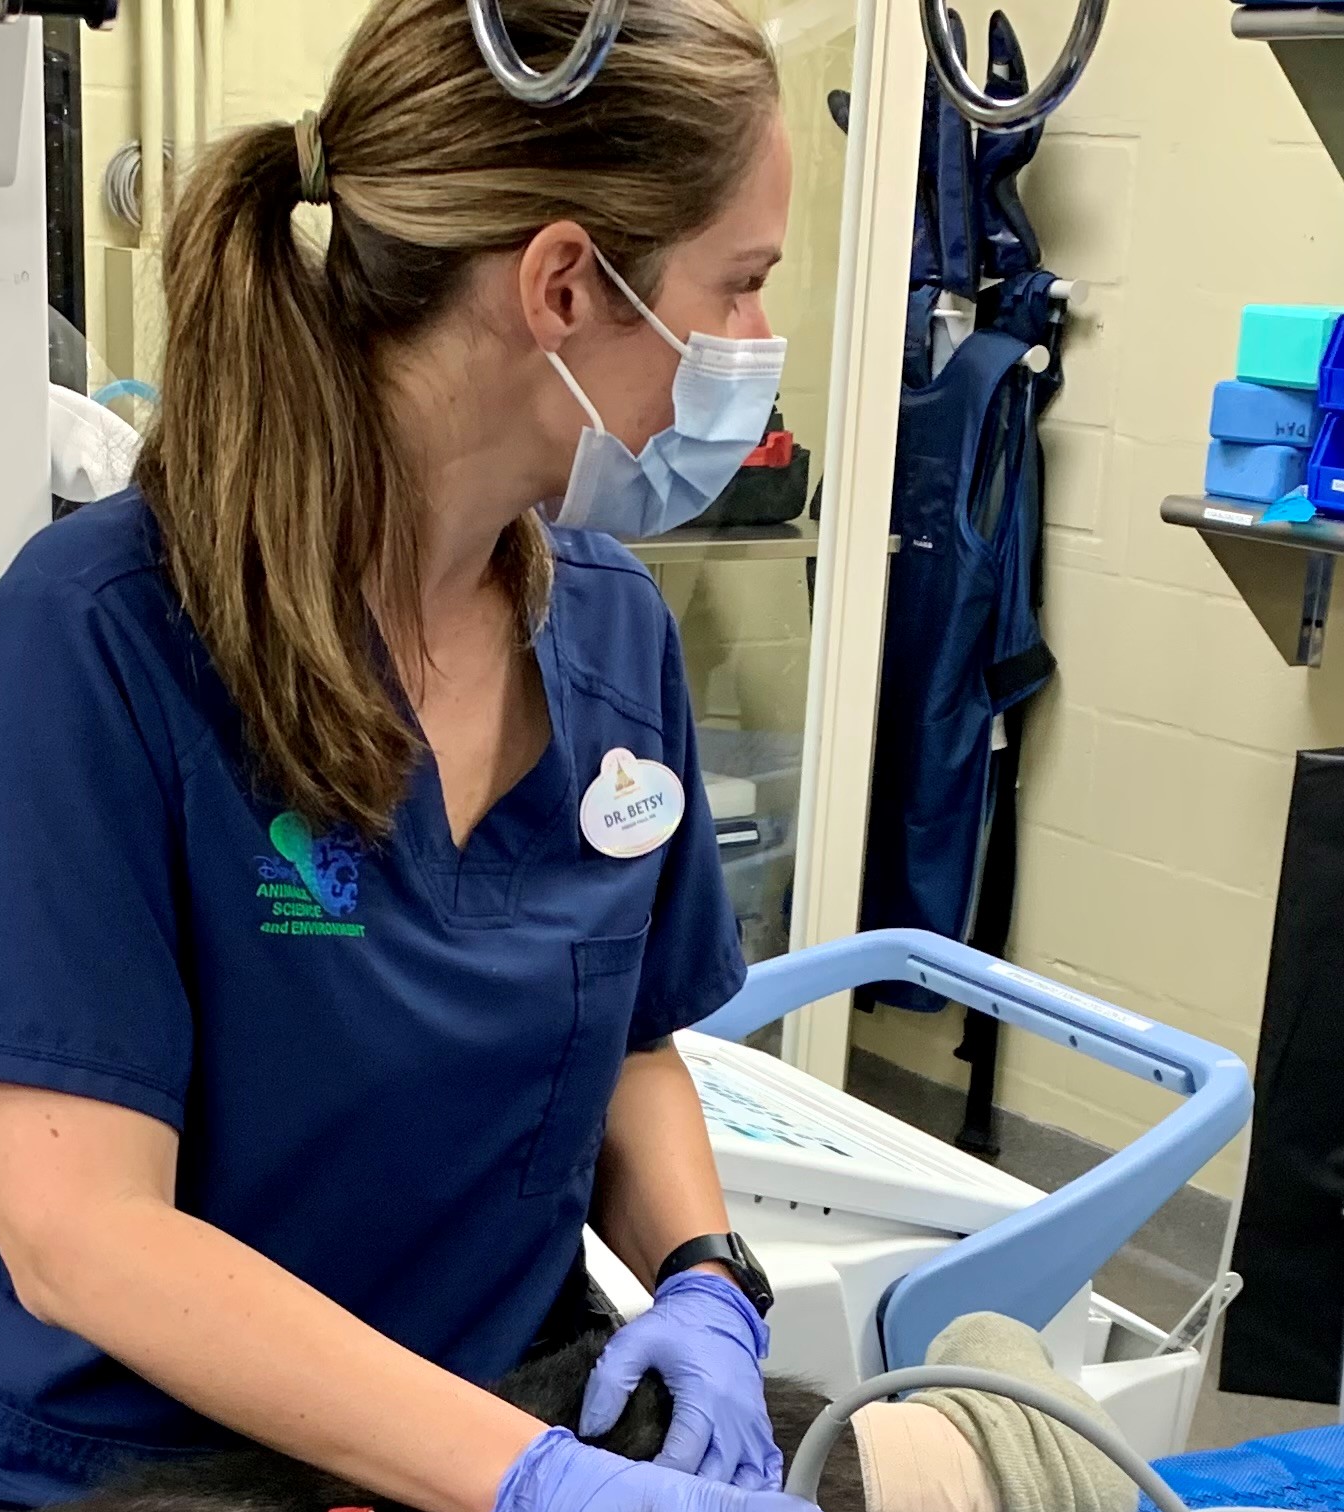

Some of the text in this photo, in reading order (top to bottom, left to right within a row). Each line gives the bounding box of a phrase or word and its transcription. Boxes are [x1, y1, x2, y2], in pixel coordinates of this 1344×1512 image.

[604, 811, 626, 828] DR.
[627, 791, 664, 818] BETSY
[260, 921, 365, 937] and ENVIRONMENT
